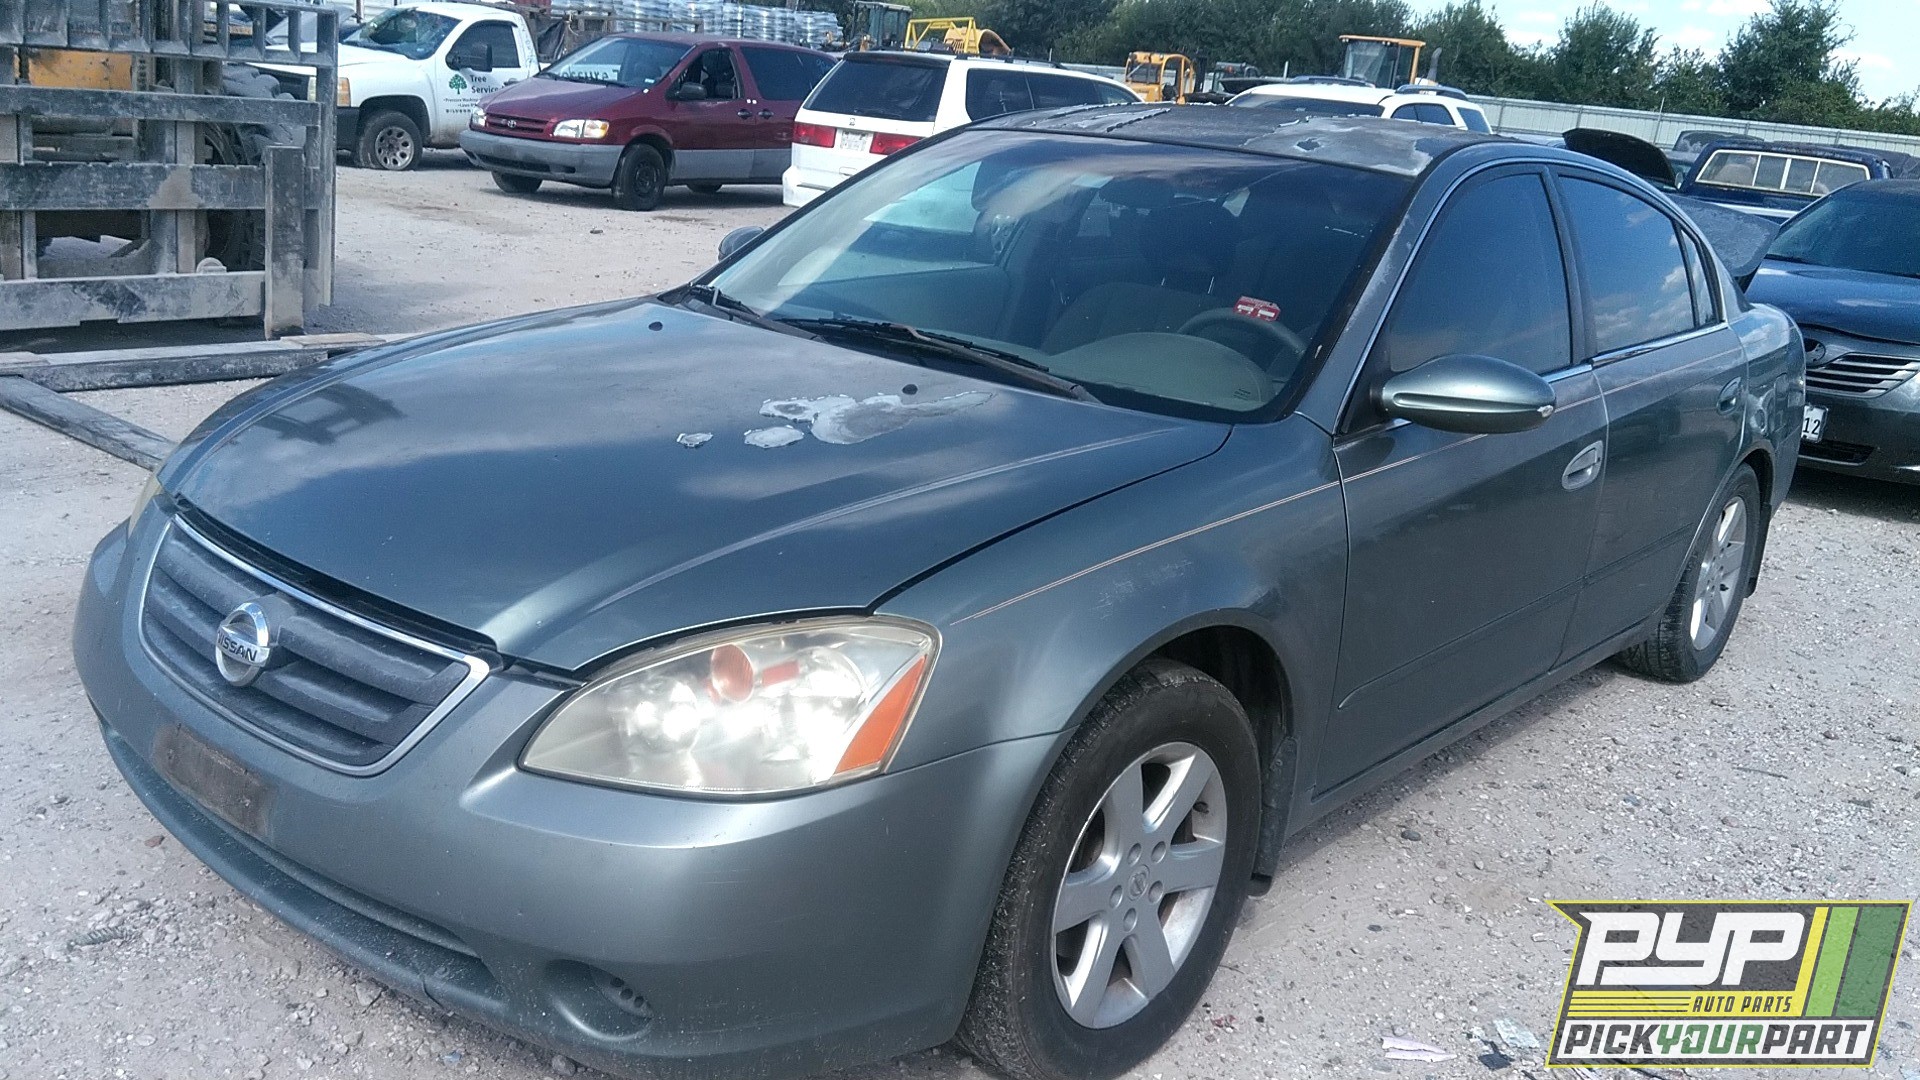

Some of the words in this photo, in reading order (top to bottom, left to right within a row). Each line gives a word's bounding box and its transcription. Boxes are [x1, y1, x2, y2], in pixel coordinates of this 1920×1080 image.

[469, 74, 487, 83] Tree
[471, 85, 499, 94] Service
[217, 631, 258, 662] NISSAN
